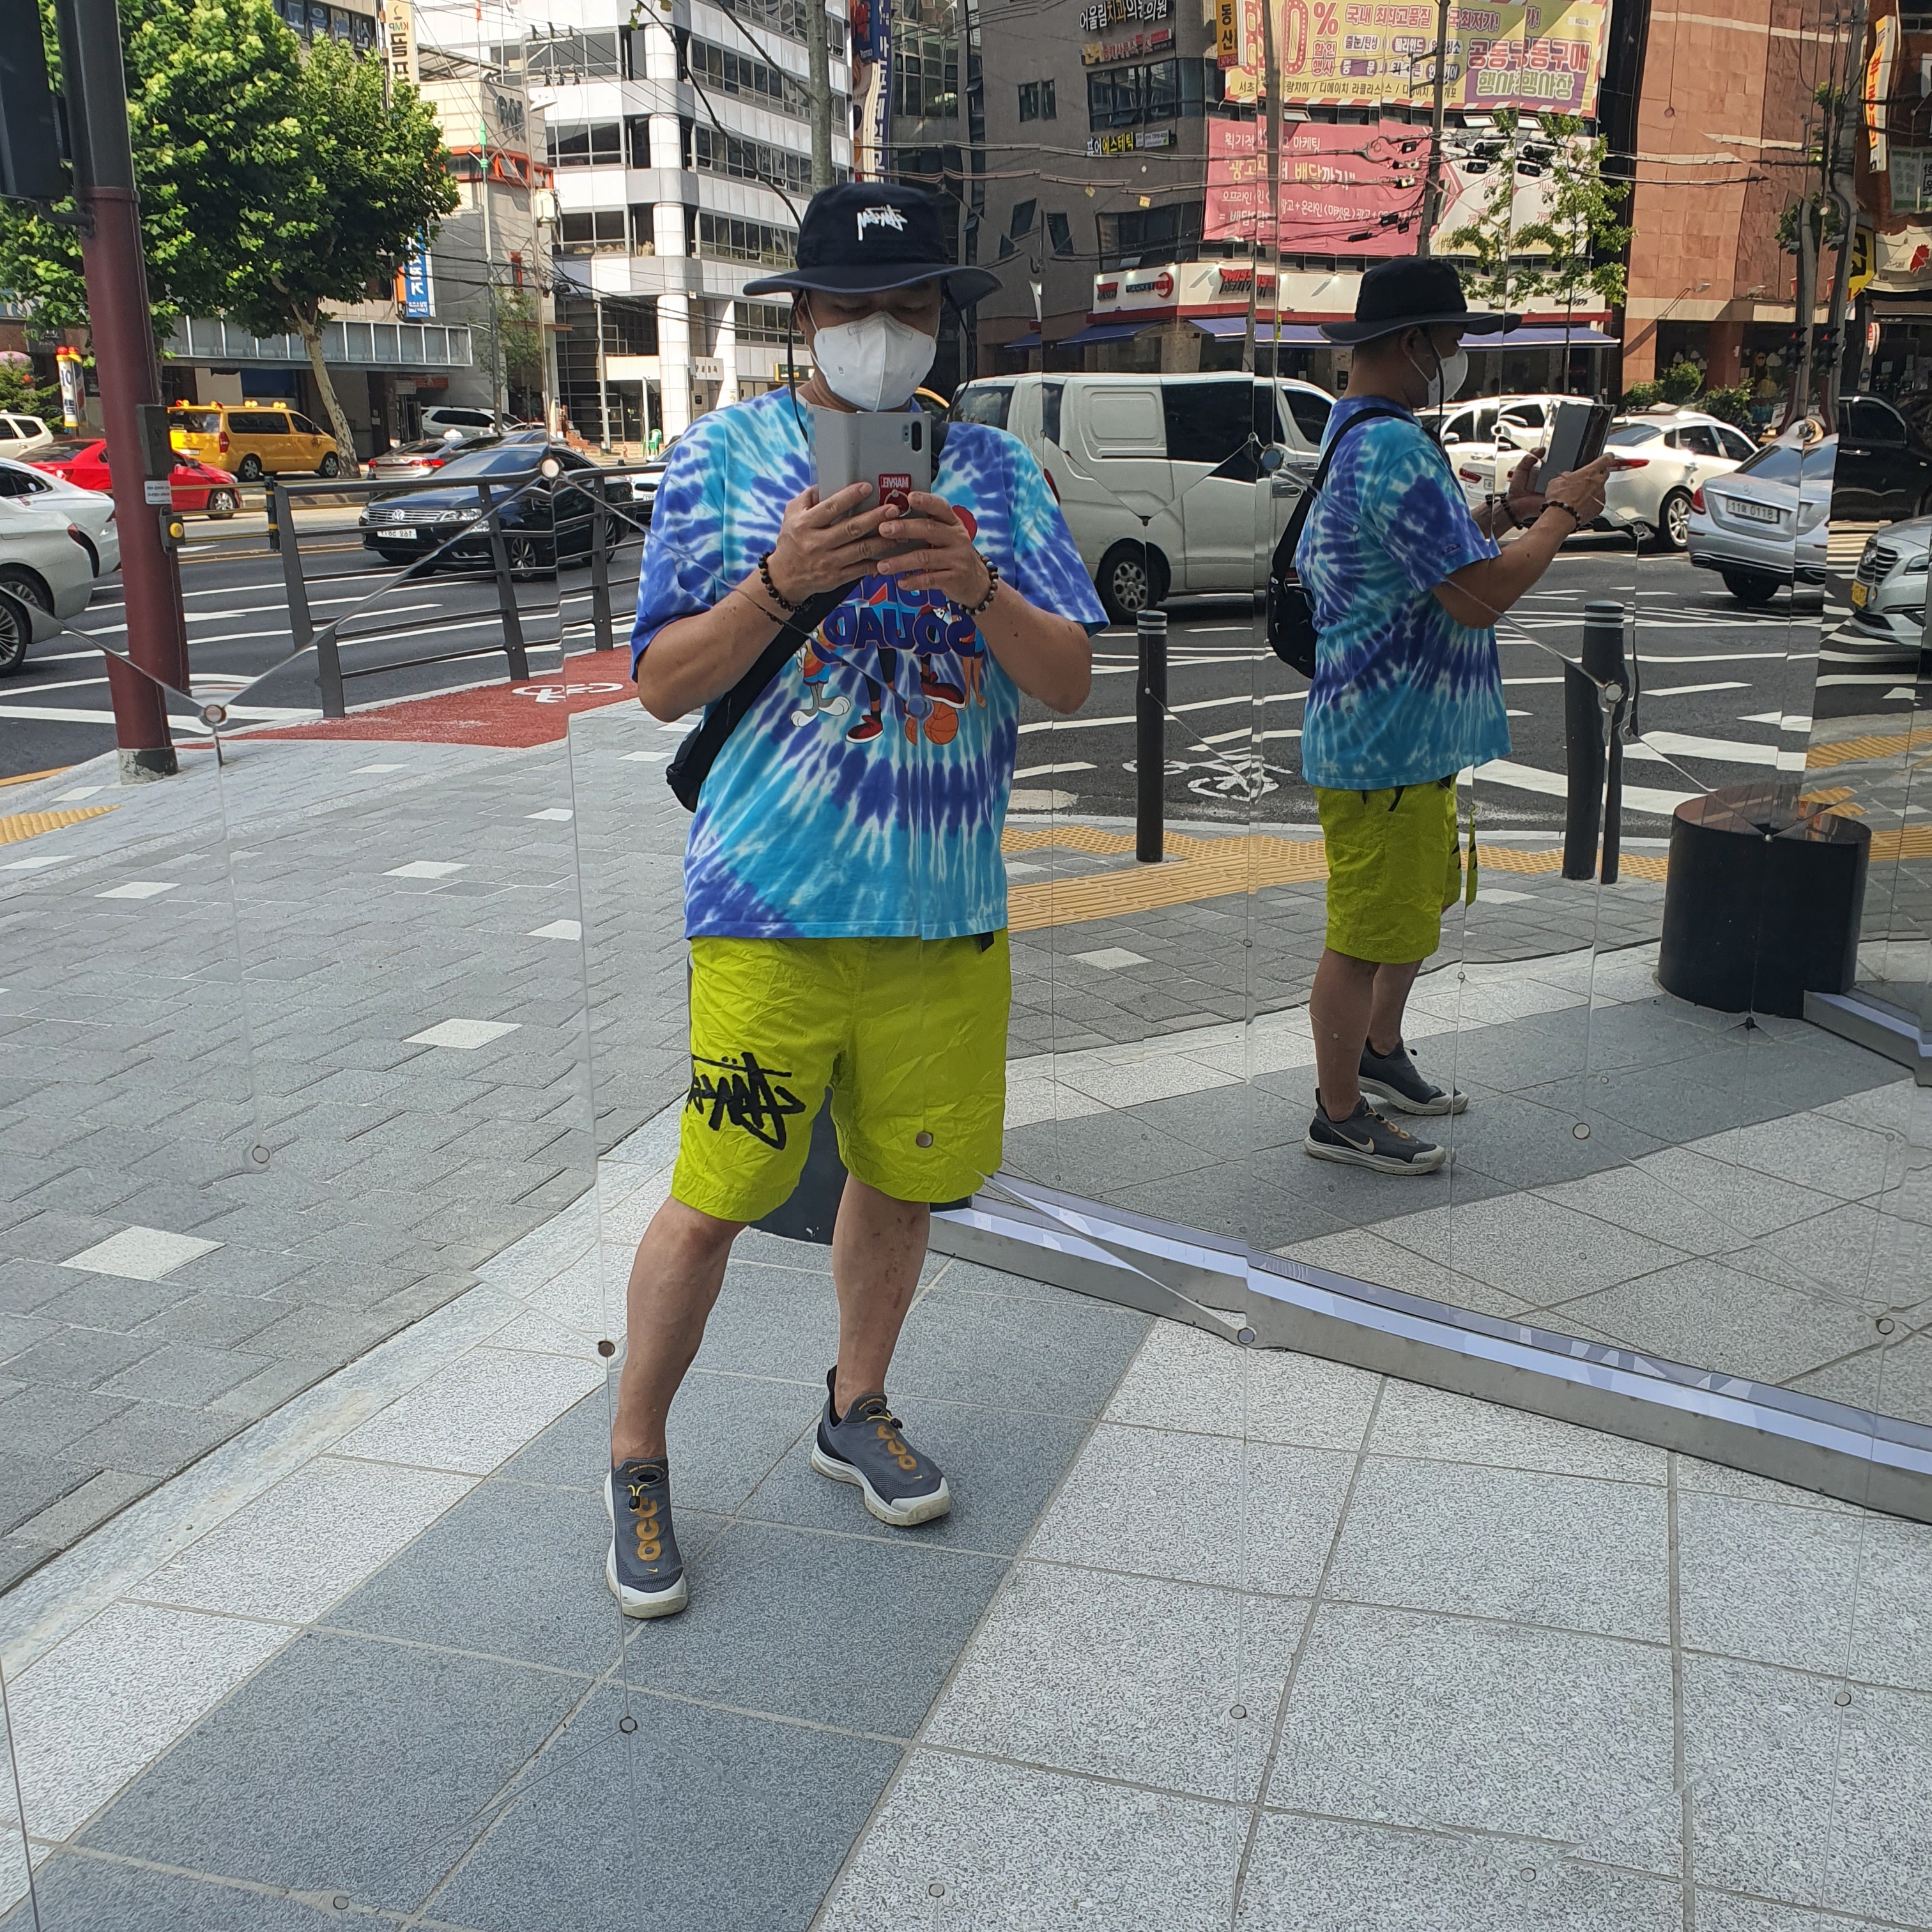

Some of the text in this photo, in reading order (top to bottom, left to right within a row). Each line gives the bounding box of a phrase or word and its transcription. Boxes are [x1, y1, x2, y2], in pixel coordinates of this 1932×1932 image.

[1346, 4, 1372, 25] 국내
[1313, 40, 1337, 57] 할인
[1395, 37, 1424, 53] 블라인드
[1312, 58, 1335, 76] 행사
[1320, 81, 1349, 95] 디에이치
[1292, 135, 1321, 153] 마케팅
[1221, 190, 1252, 206] 오프라인
[1750, 505, 1774, 519] 0118
